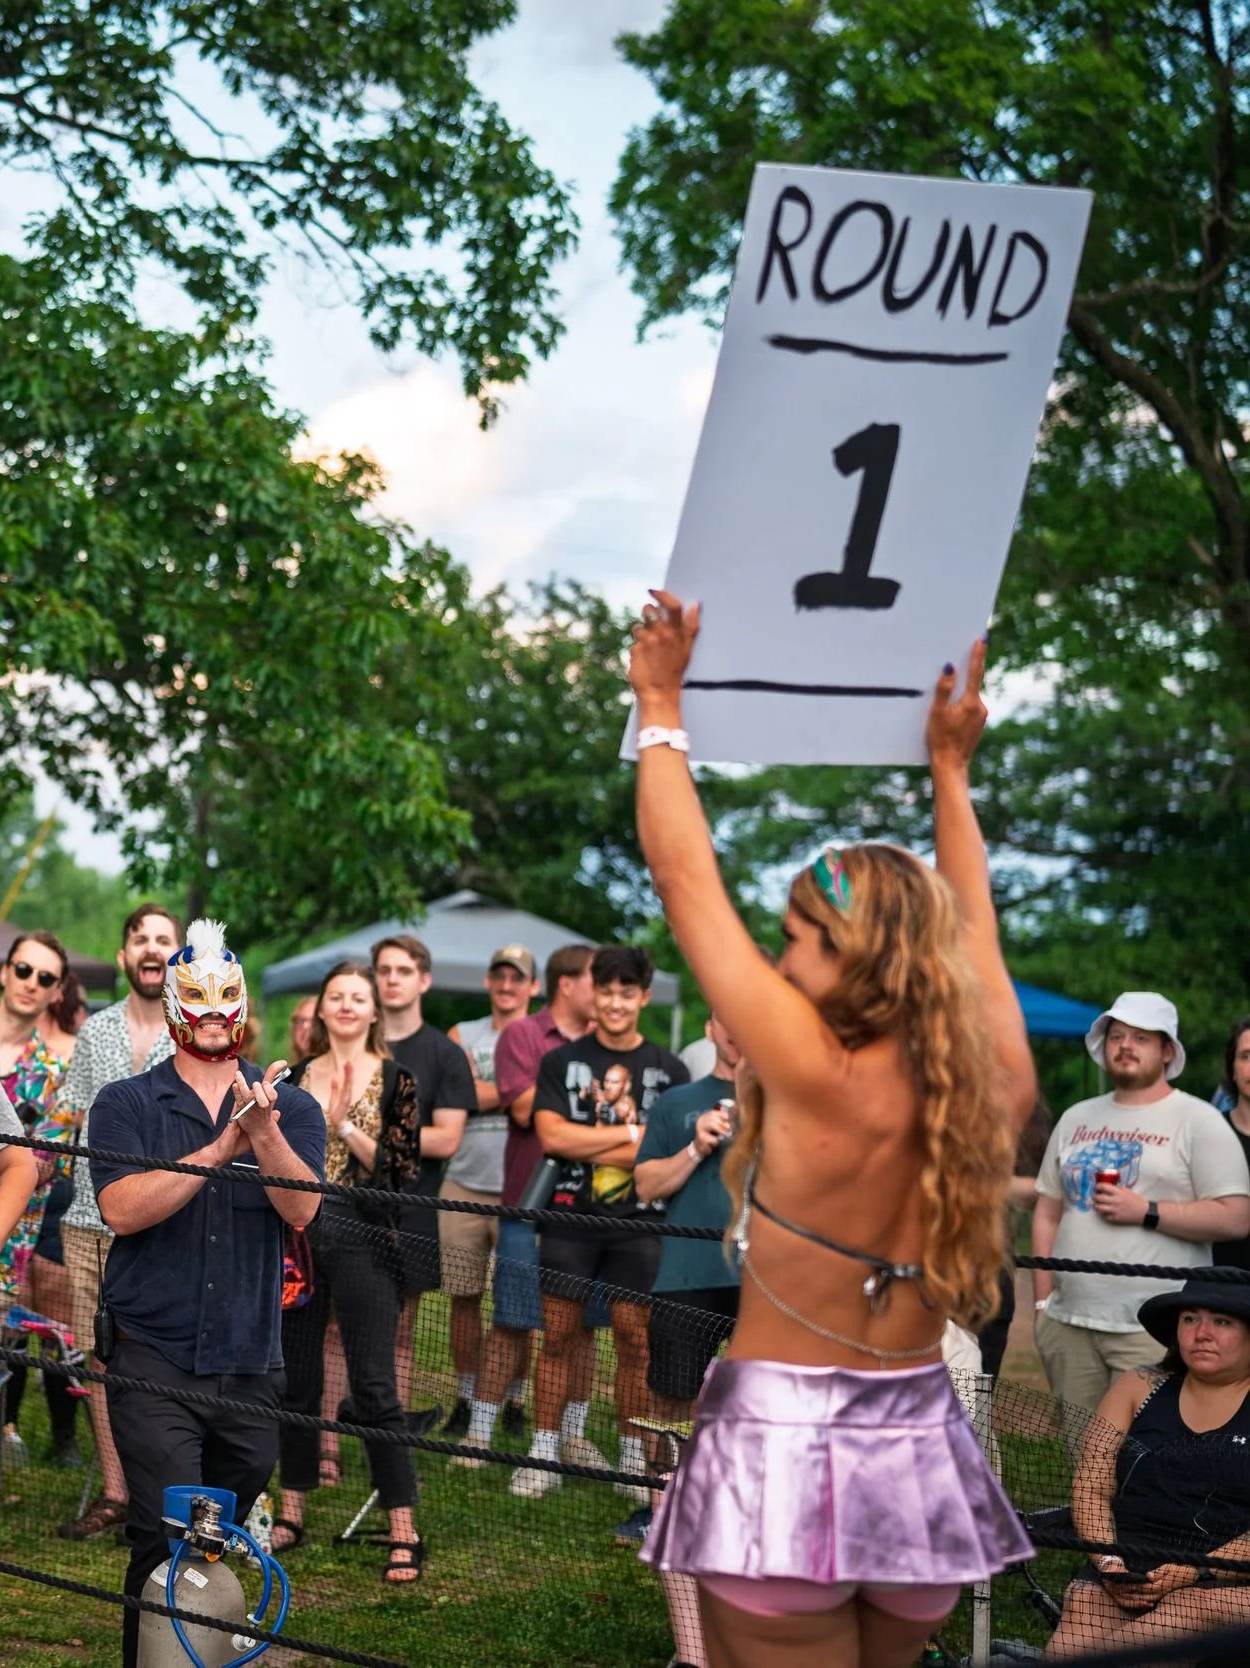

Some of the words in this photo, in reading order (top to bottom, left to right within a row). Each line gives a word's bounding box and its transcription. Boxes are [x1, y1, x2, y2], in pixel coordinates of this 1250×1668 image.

[756, 185, 1049, 327] ROUND
[793, 422, 902, 612] 1
[1069, 1124, 1170, 1147] Budweiser
